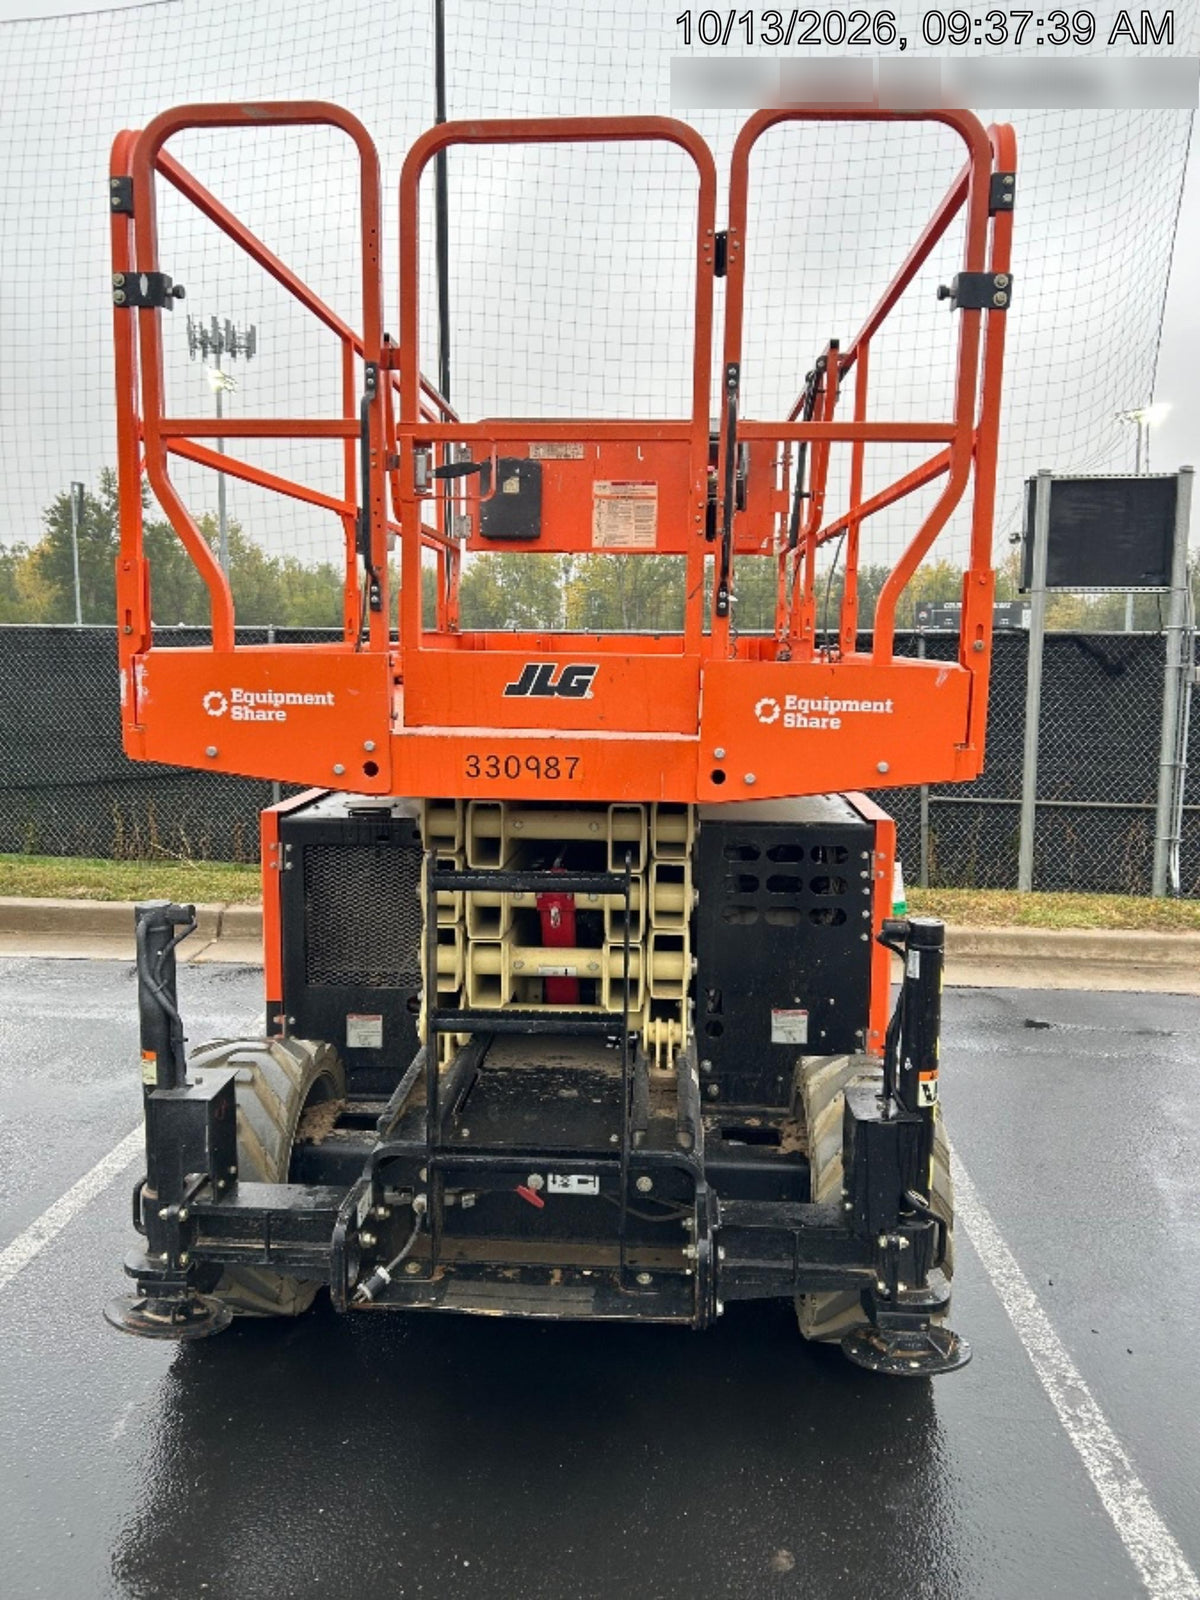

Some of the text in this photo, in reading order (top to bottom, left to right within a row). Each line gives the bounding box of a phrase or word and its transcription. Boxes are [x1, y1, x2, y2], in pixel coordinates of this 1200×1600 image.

[502, 663, 598, 699] JLG
[230, 688, 335, 707] Equipment
[784, 695, 893, 714] Equipment
[230, 705, 287, 722] Share
[783, 713, 841, 729] Share
[465, 754, 580, 779] 330987
